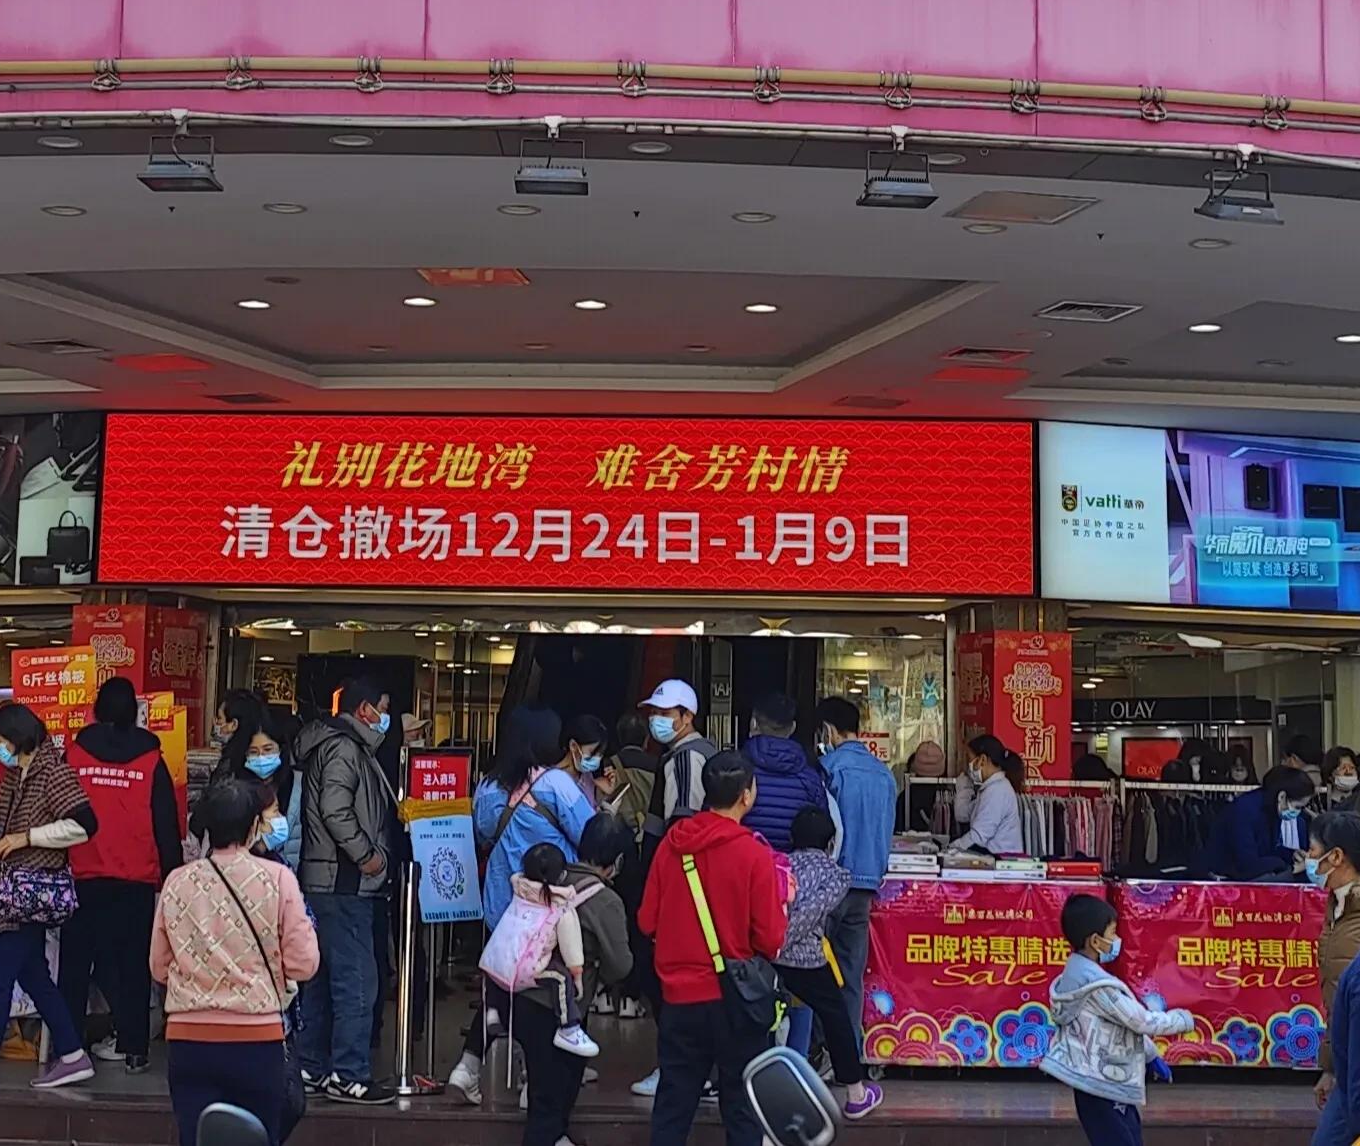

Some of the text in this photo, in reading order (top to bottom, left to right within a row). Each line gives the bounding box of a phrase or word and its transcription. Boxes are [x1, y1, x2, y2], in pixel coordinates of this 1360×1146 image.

[279, 440, 851, 494] 礼别花地湾 难舍芳村情
[1084, 494, 1122, 509] vatti
[219, 503, 910, 568] 清仓撤场12月24日-1月9日
[1109, 700, 1157, 720] OLAY
[905, 933, 1072, 967] 品牌特惠精选
[1177, 936, 1320, 968] 品牌特惠精
[932, 961, 1049, 986] Sale
[1204, 963, 1318, 989] Sale
